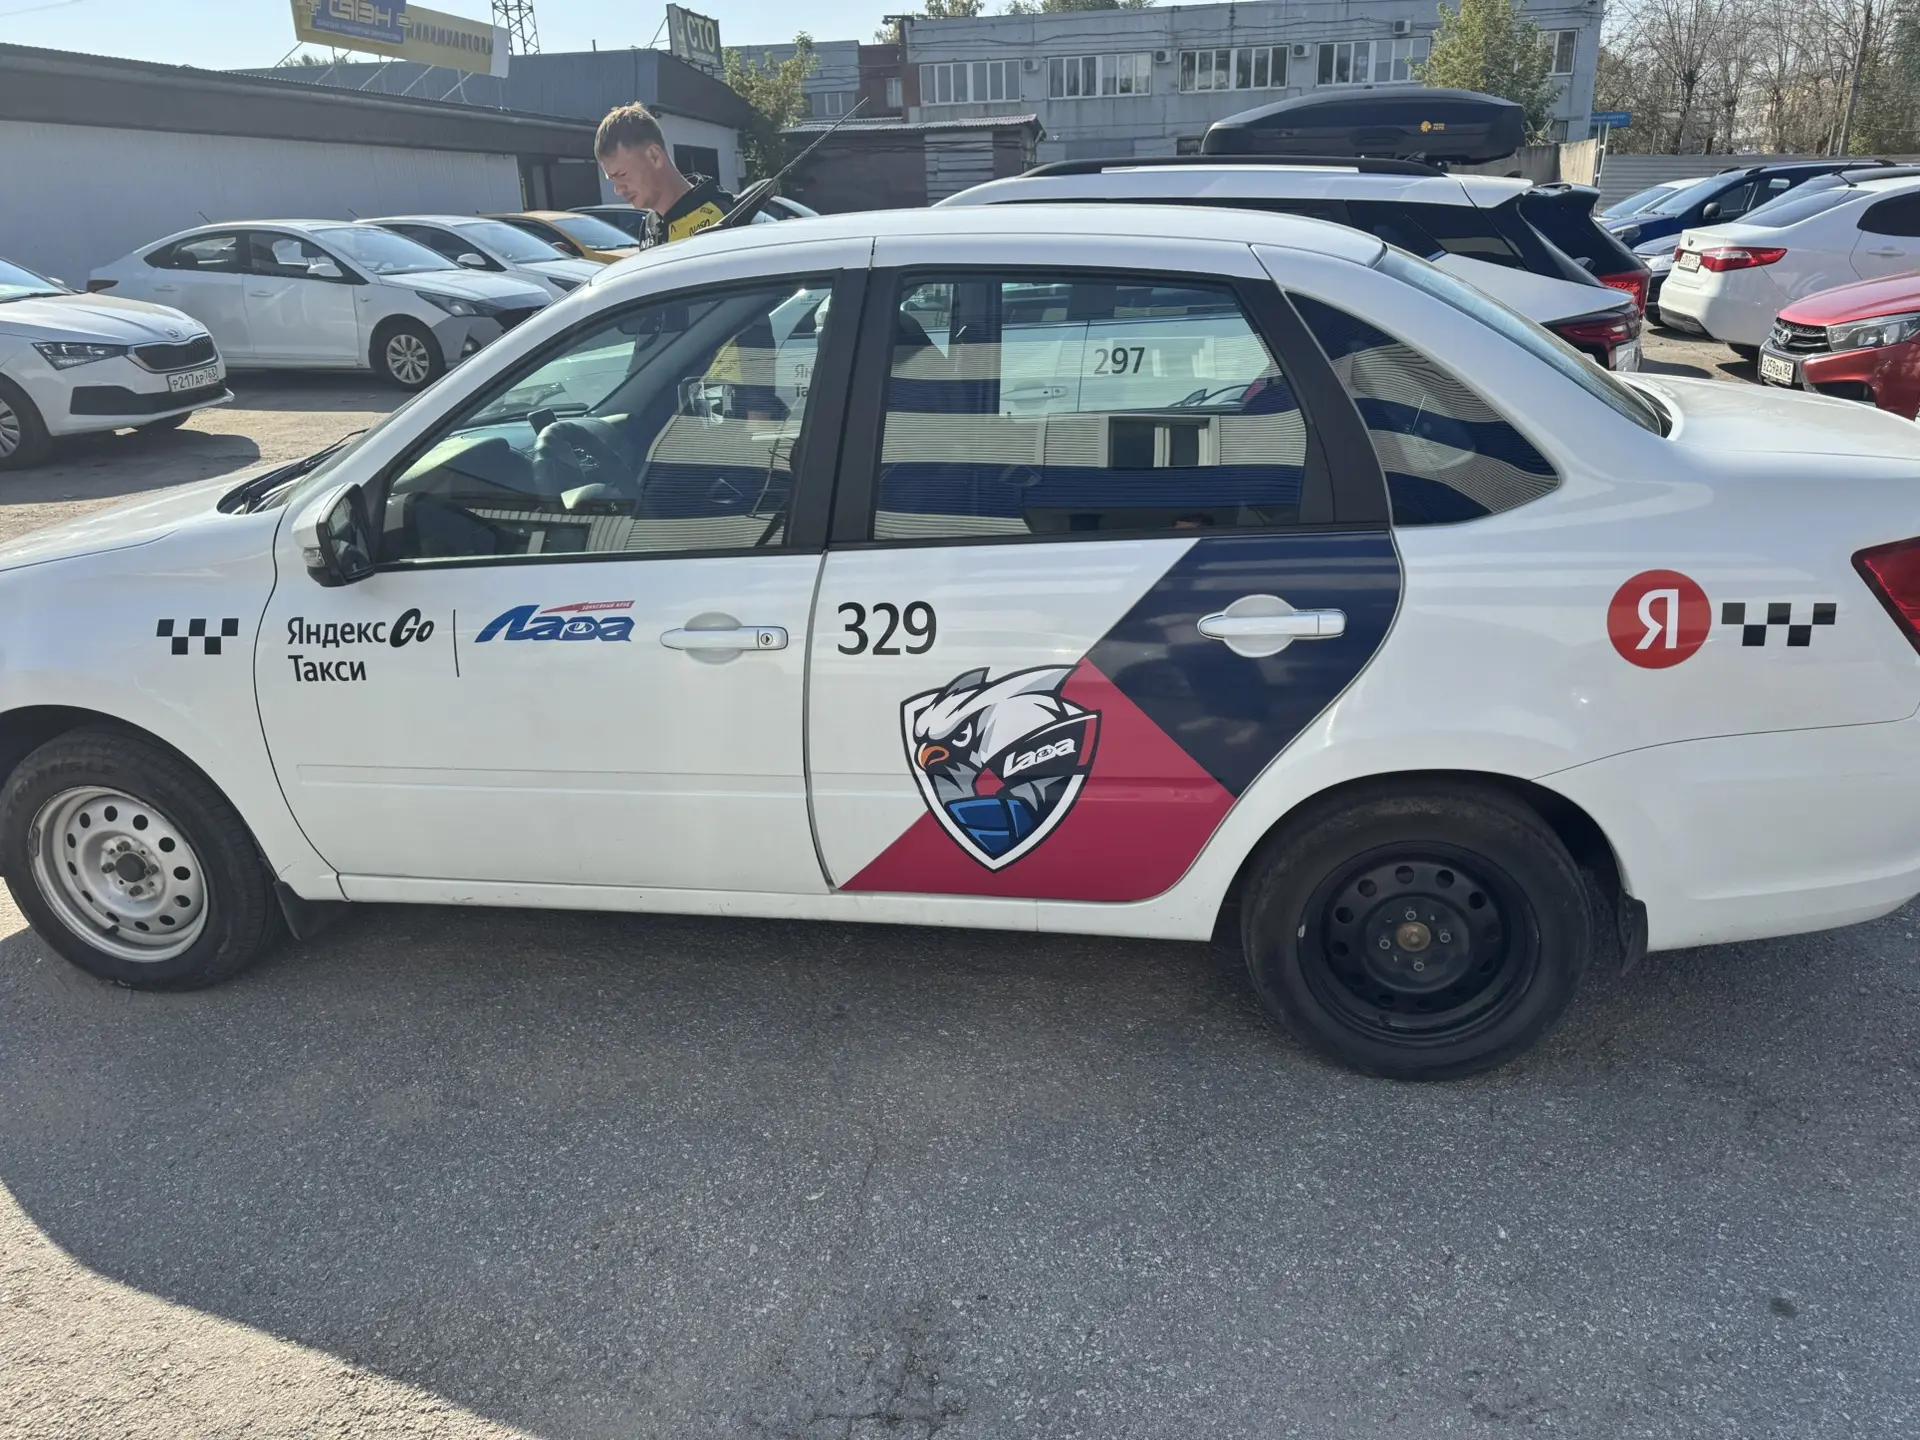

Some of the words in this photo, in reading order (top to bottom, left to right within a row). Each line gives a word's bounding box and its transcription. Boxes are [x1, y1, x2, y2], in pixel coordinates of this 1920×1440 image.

[686, 15, 716, 54] СТО
[1094, 346, 1145, 375] 297
[287, 616, 387, 648] Яндекс
[389, 607, 435, 648] Go
[837, 600, 937, 655] 329
[1635, 588, 1679, 650] Я
[287, 654, 367, 682] Такси
